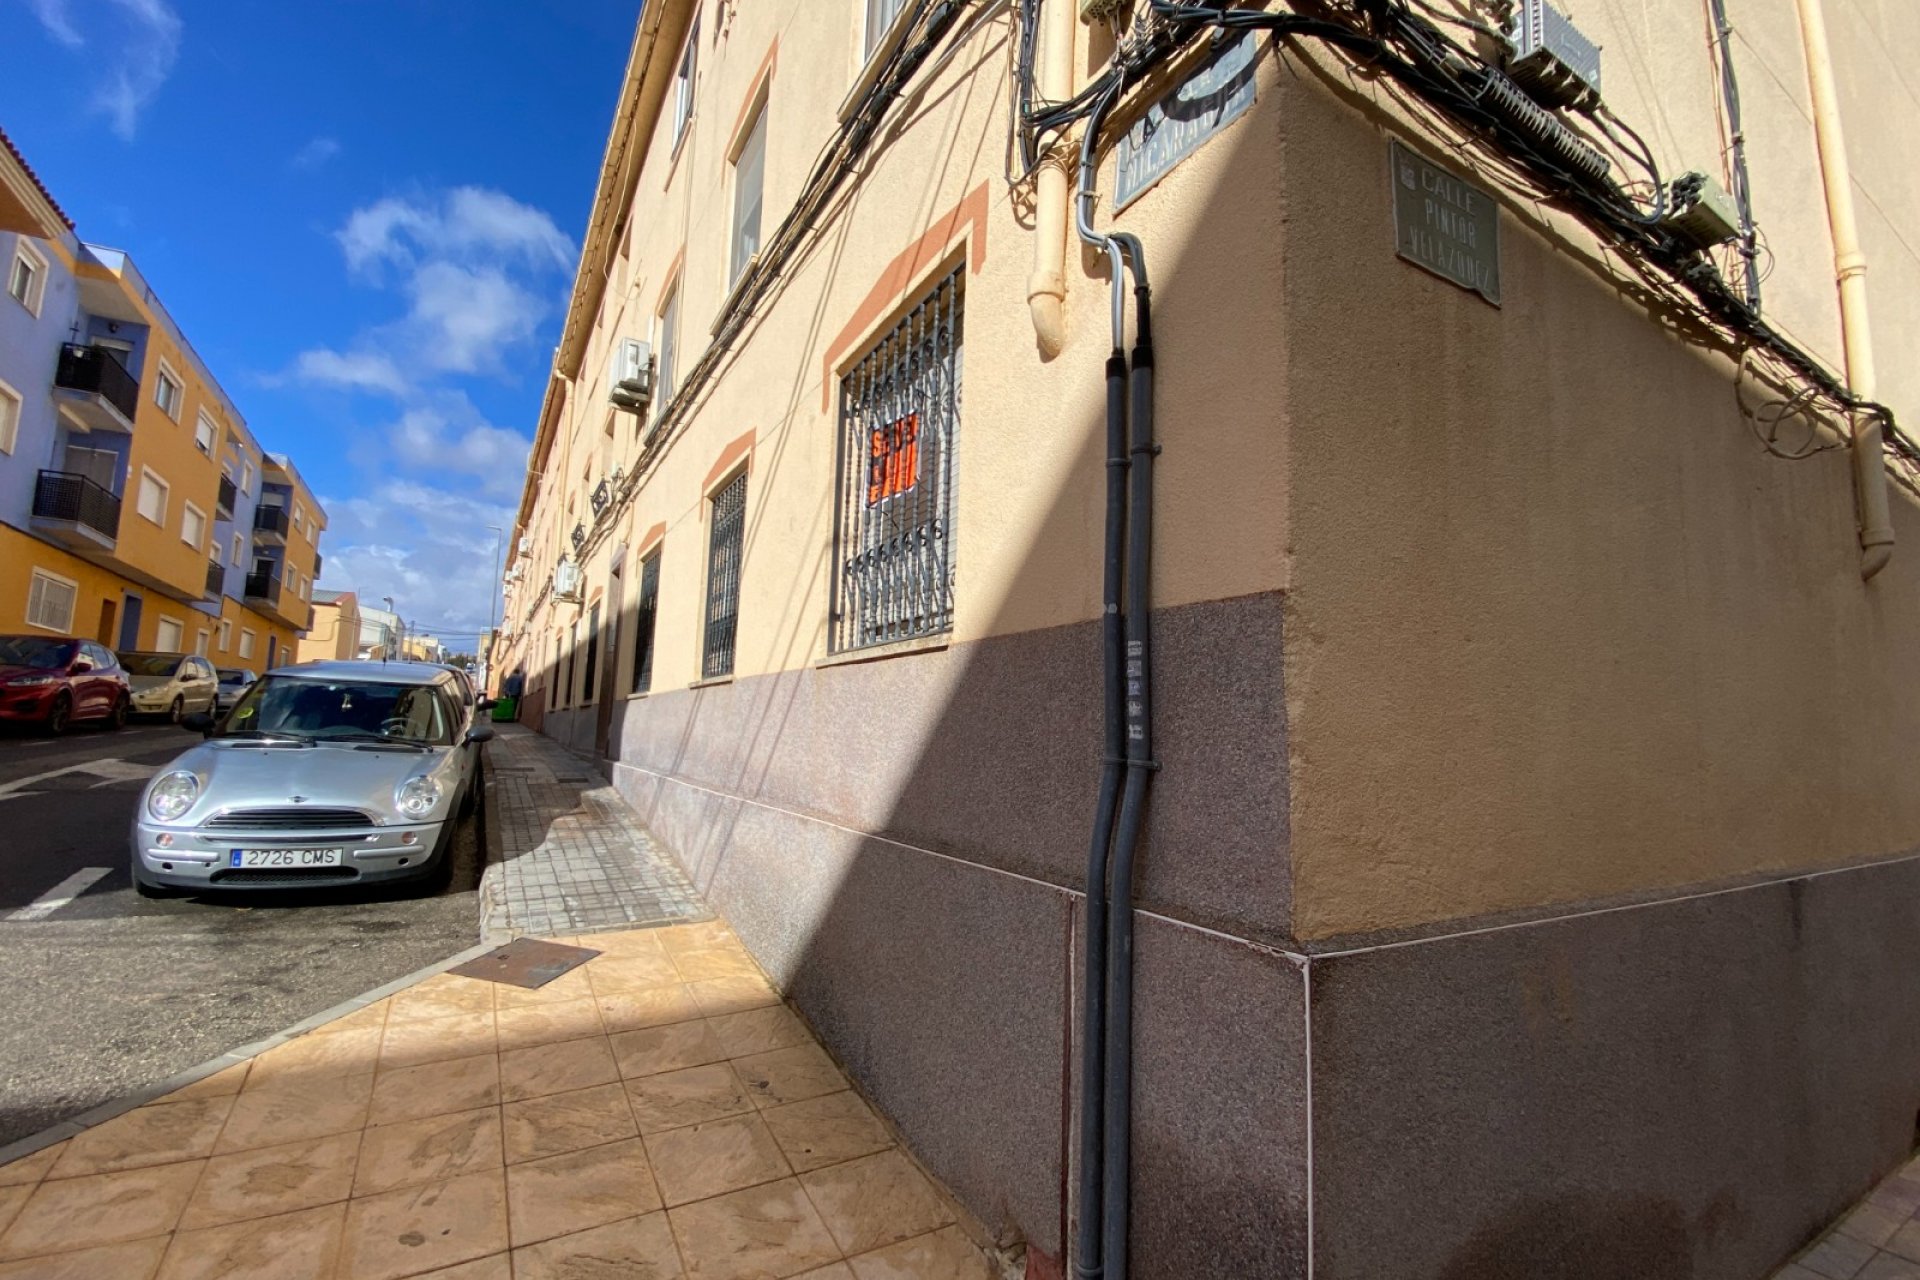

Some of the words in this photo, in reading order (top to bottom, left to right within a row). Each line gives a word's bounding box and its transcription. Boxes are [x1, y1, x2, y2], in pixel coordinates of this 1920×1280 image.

[1421, 166, 1476, 218] CALLE
[1424, 197, 1476, 249] PINTOR
[247, 850, 294, 865] 2726
[301, 849, 335, 864] CMS
